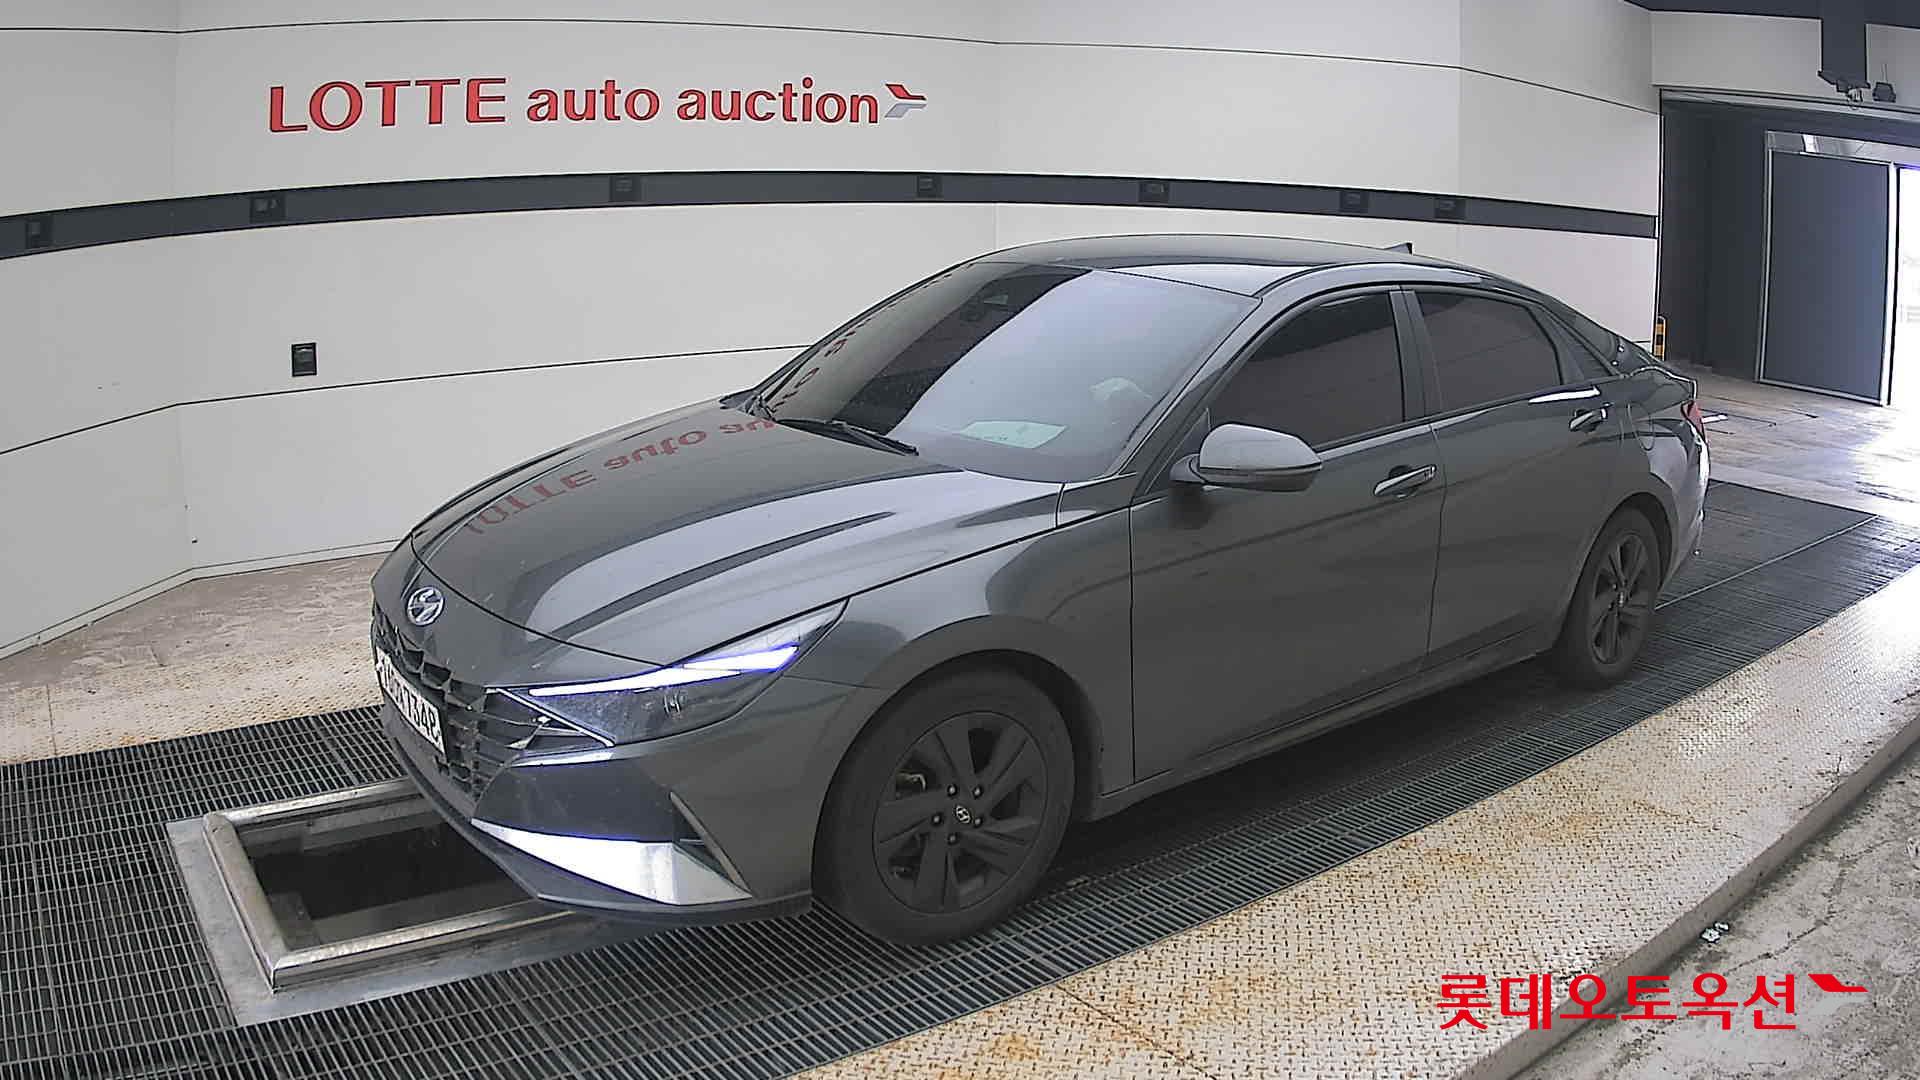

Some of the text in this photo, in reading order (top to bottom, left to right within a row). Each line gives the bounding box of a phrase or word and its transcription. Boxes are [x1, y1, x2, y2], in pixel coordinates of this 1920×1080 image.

[269, 77, 879, 132] LOTTE auto auction
